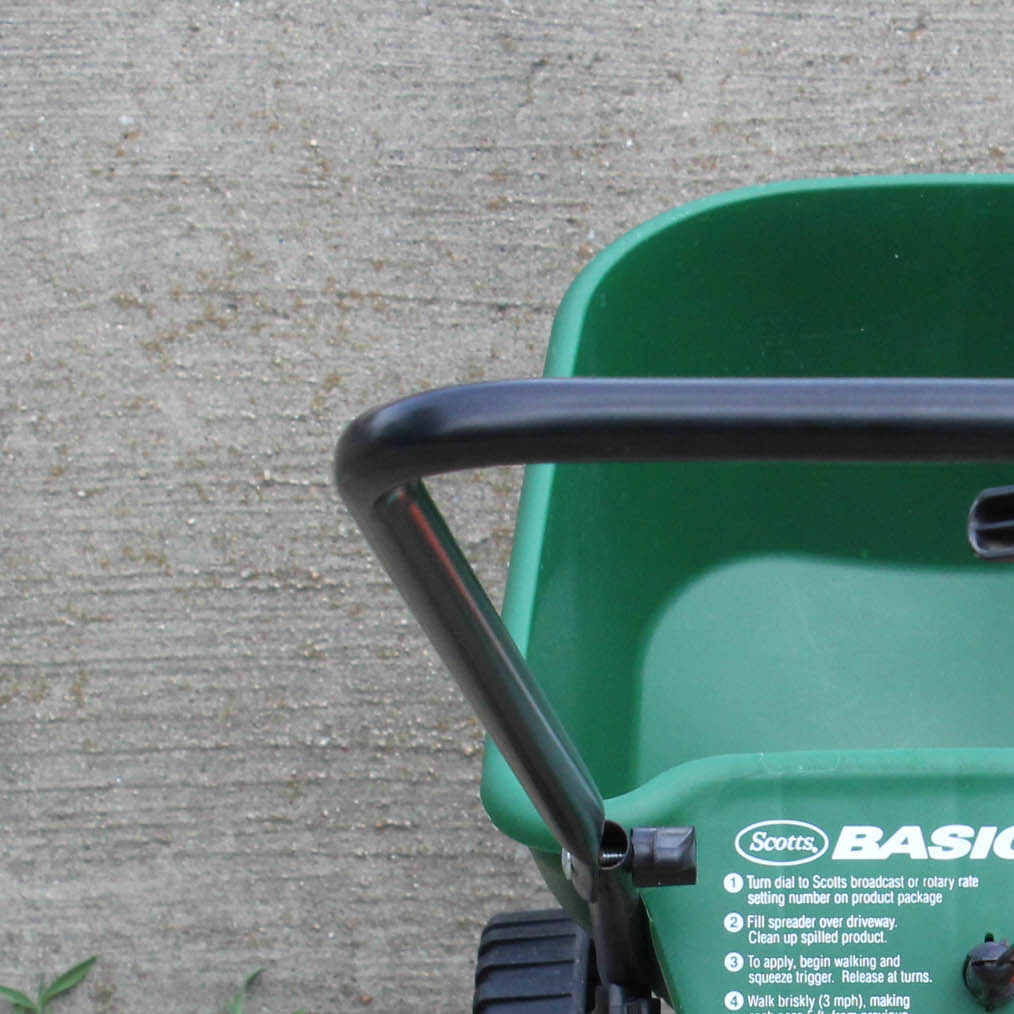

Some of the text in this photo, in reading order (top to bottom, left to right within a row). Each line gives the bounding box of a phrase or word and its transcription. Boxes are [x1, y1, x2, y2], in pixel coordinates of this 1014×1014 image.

[749, 831, 817, 853] Scotts
[747, 874, 772, 889] Turn
[774, 876, 795, 889] dial
[798, 876, 810, 889] to
[812, 875, 848, 889] Scotts
[850, 874, 905, 888] broadcast
[907, 877, 919, 888] or
[923, 876, 955, 890] rotary
[957, 875, 979, 888] rate
[747, 890, 943, 907] setting number on product package
[746, 915, 765, 929] Fill
[768, 915, 816, 931] spreader
[819, 917, 845, 928] over
[846, 914, 897, 931] driveway.
[748, 930, 887, 946] Clean up spilled product.
[748, 955, 760, 968] To
[763, 955, 798, 971] apply,
[800, 955, 831, 970] begin
[834, 955, 877, 971] walking
[880, 954, 900, 968] and
[748, 970, 932, 986] squeeze trigger. Release at turns.
[747, 994, 775, 1008] Walk
[778, 994, 816, 1011] briskly
[819, 994, 830, 1011] (3
[834, 994, 866, 1009] mph),
[869, 994, 910, 1010] making
